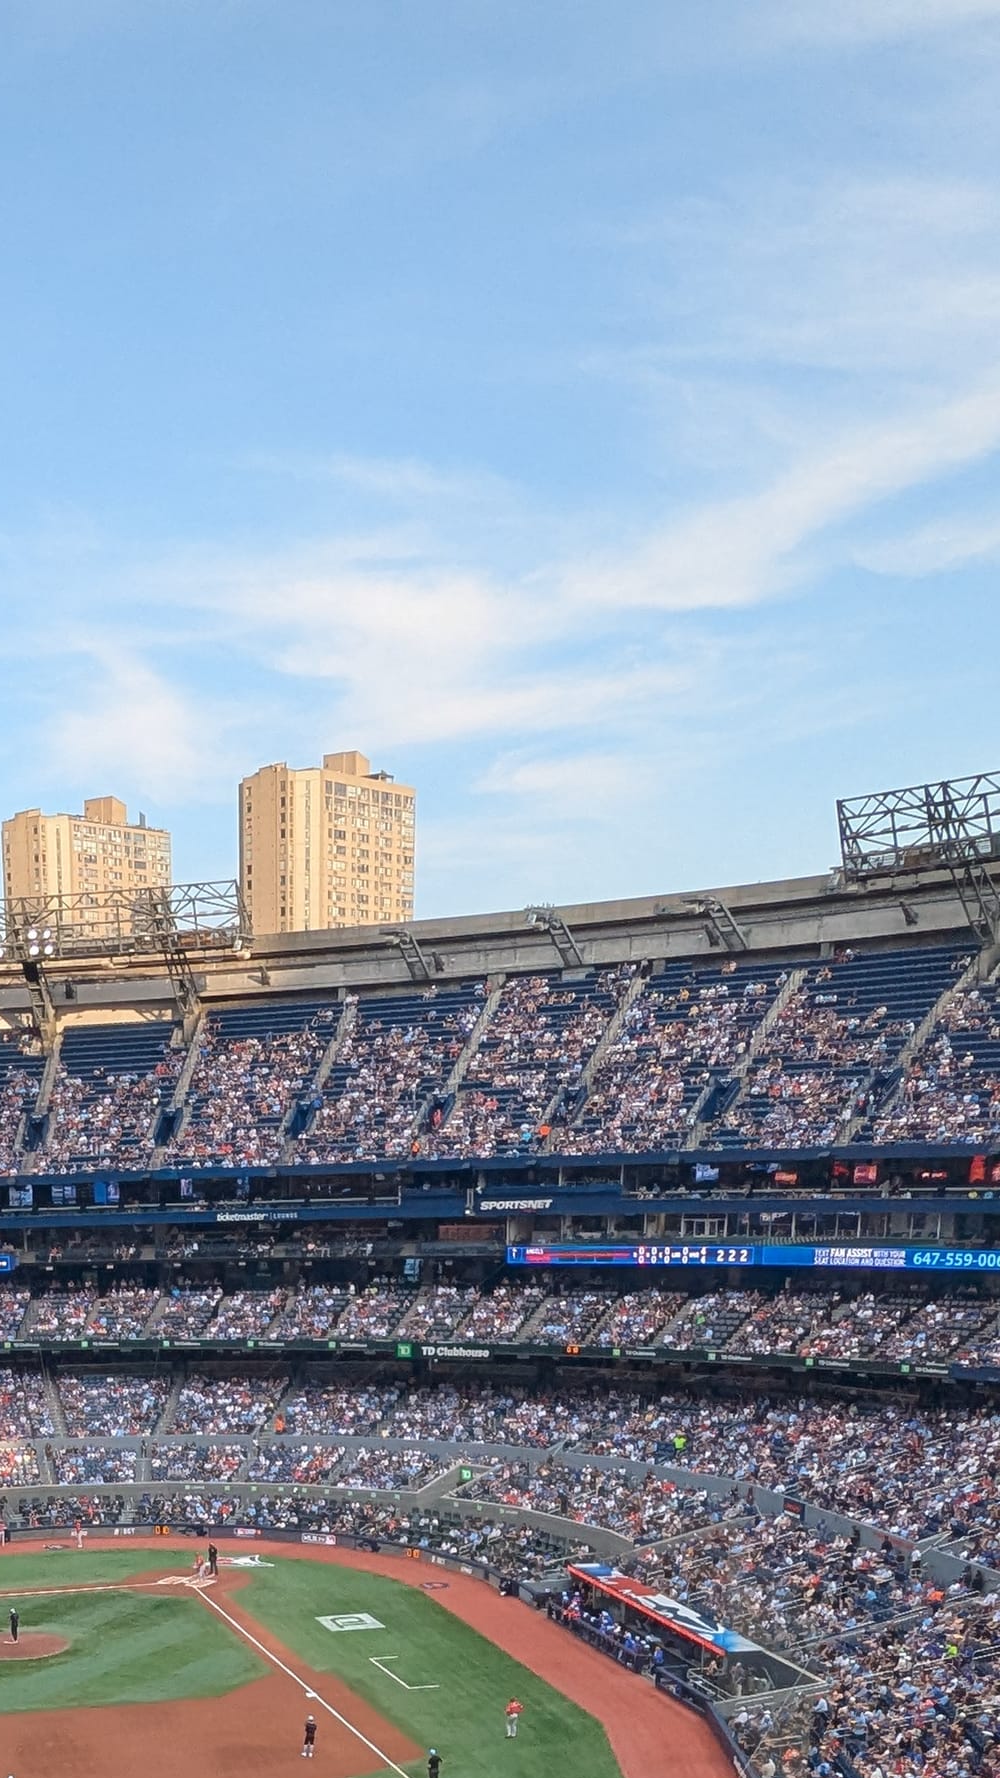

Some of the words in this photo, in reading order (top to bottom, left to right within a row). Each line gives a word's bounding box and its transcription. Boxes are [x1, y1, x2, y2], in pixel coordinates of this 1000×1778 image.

[480, 1199, 553, 1211] SPORTSNET
[216, 1212, 265, 1222] ticketmaster
[717, 1249, 724, 1262] 2
[728, 1249, 736, 1262] 2
[740, 1249, 748, 1262] 2
[830, 1247, 845, 1258] FAN
[847, 1247, 872, 1258] ASSIST
[422, 1346, 435, 1356] TD
[437, 1347, 490, 1358] Clubhouse
